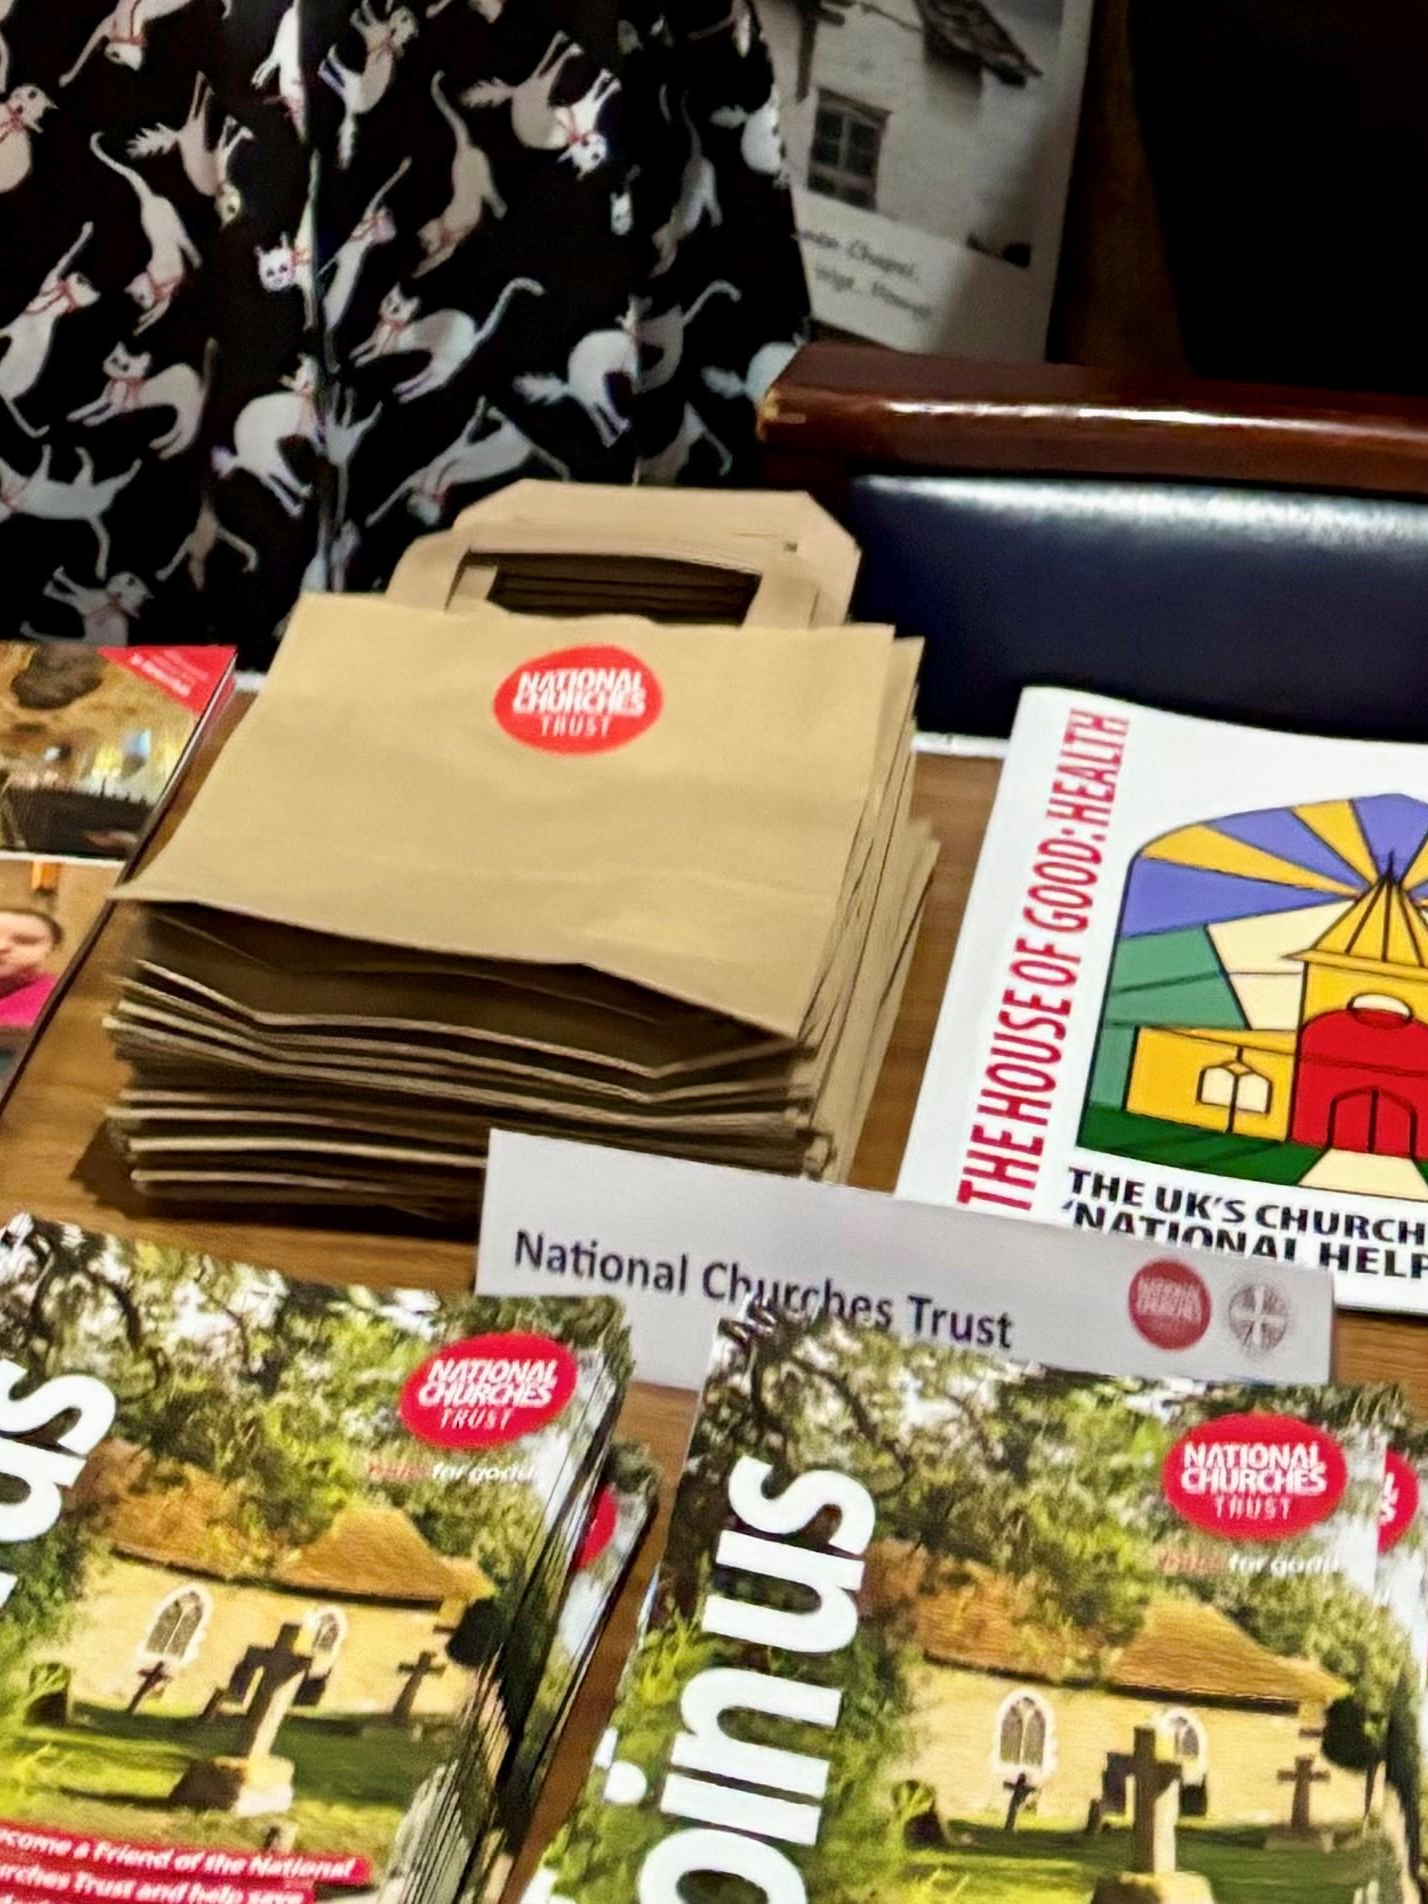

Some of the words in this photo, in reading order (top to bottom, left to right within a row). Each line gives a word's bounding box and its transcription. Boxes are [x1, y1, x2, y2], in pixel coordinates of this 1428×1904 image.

[518, 667, 644, 694] NATIONAL
[512, 688, 647, 717] CHURCHES
[540, 715, 613, 738] TRUST
[1045, 708, 1131, 828] HEALTH
[1022, 826, 1108, 935] GOOD:
[1009, 936, 1083, 989] OF
[975, 988, 1074, 1127] HOUSE
[955, 1124, 1047, 1211] THE
[1069, 1166, 1145, 1207] THE
[1155, 1185, 1246, 1224] UK'S
[513, 1228, 688, 1296] National
[701, 1261, 894, 1329] Churches
[907, 1294, 1013, 1349] Trust
[427, 1359, 558, 1385] NATIONAL
[418, 1382, 555, 1409] CHURCHES
[439, 1408, 514, 1431] TRUST
[1182, 1440, 1325, 1471] NATIONAL
[1180, 1466, 1327, 1495] CHURCHES
[1212, 1495, 1293, 1520] TRUST
[701, 1454, 877, 1654] us
[73, 1840, 91, 1860] a
[93, 1841, 174, 1870] Friend
[174, 1851, 206, 1873] of
[205, 1852, 248, 1876] the
[248, 1854, 356, 1880] National
[73, 1871, 133, 1900] Trust
[136, 1880, 189, 1902] and
[188, 1883, 246, 1904] help
